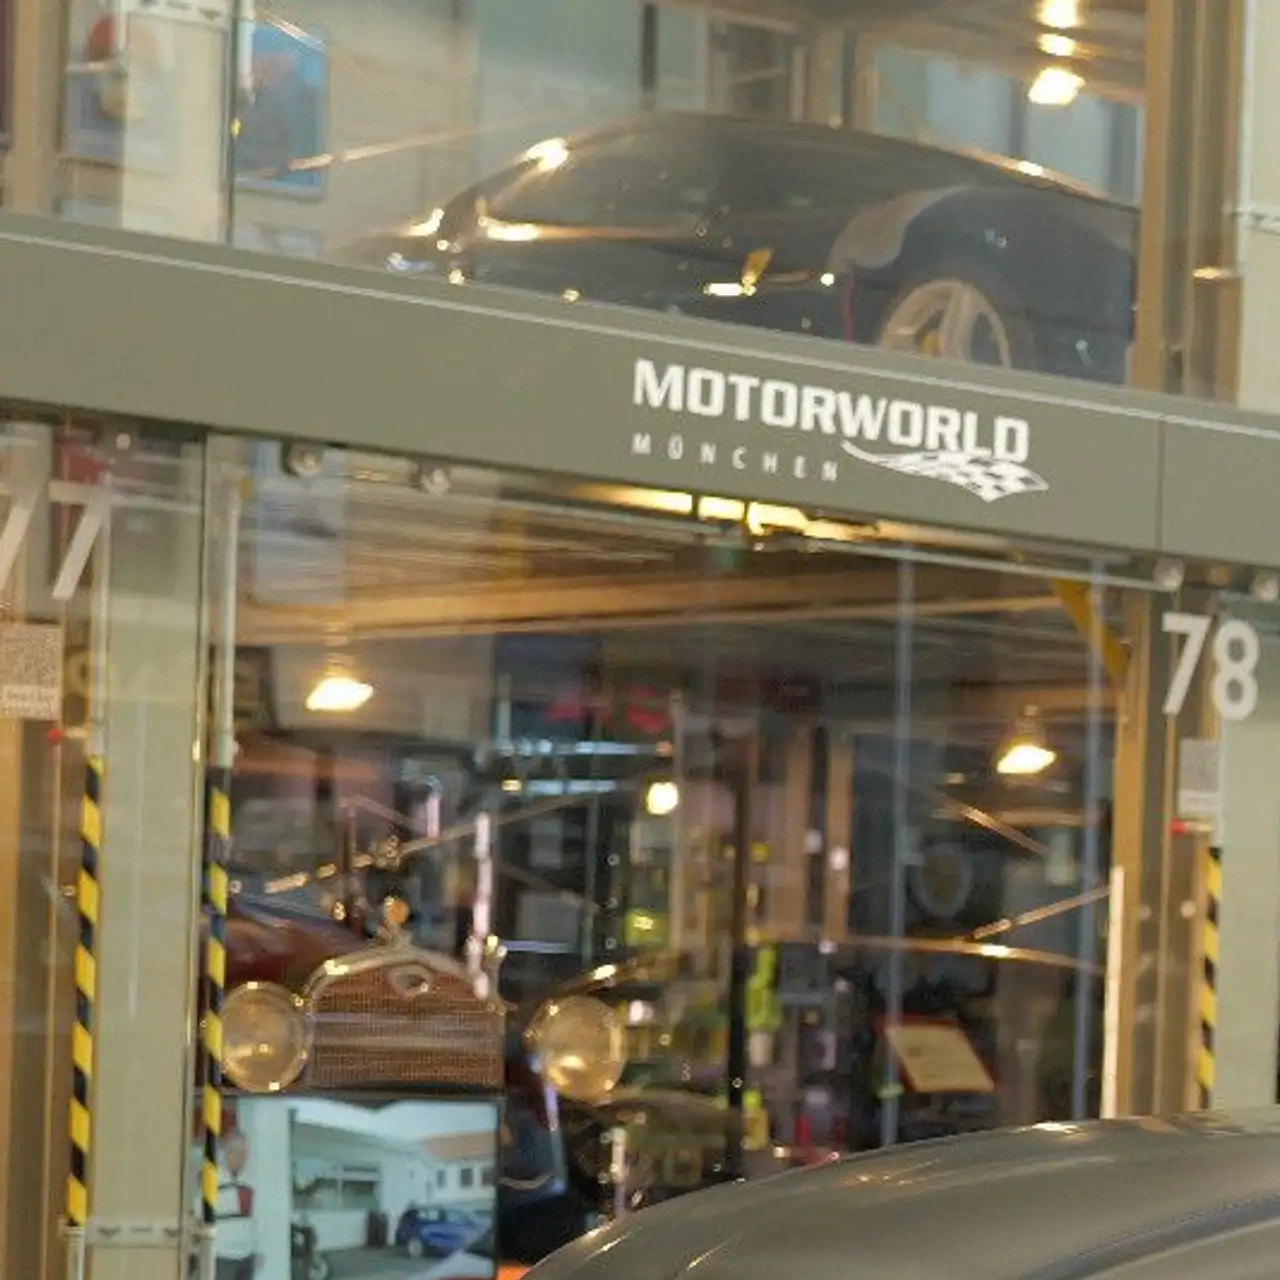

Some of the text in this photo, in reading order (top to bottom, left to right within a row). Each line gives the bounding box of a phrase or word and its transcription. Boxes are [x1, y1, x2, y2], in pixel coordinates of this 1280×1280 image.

[631, 432, 839, 483] MÜNCHEN
[633, 357, 1030, 465] MOTORWORLD
[1161, 612, 1260, 722] 78
